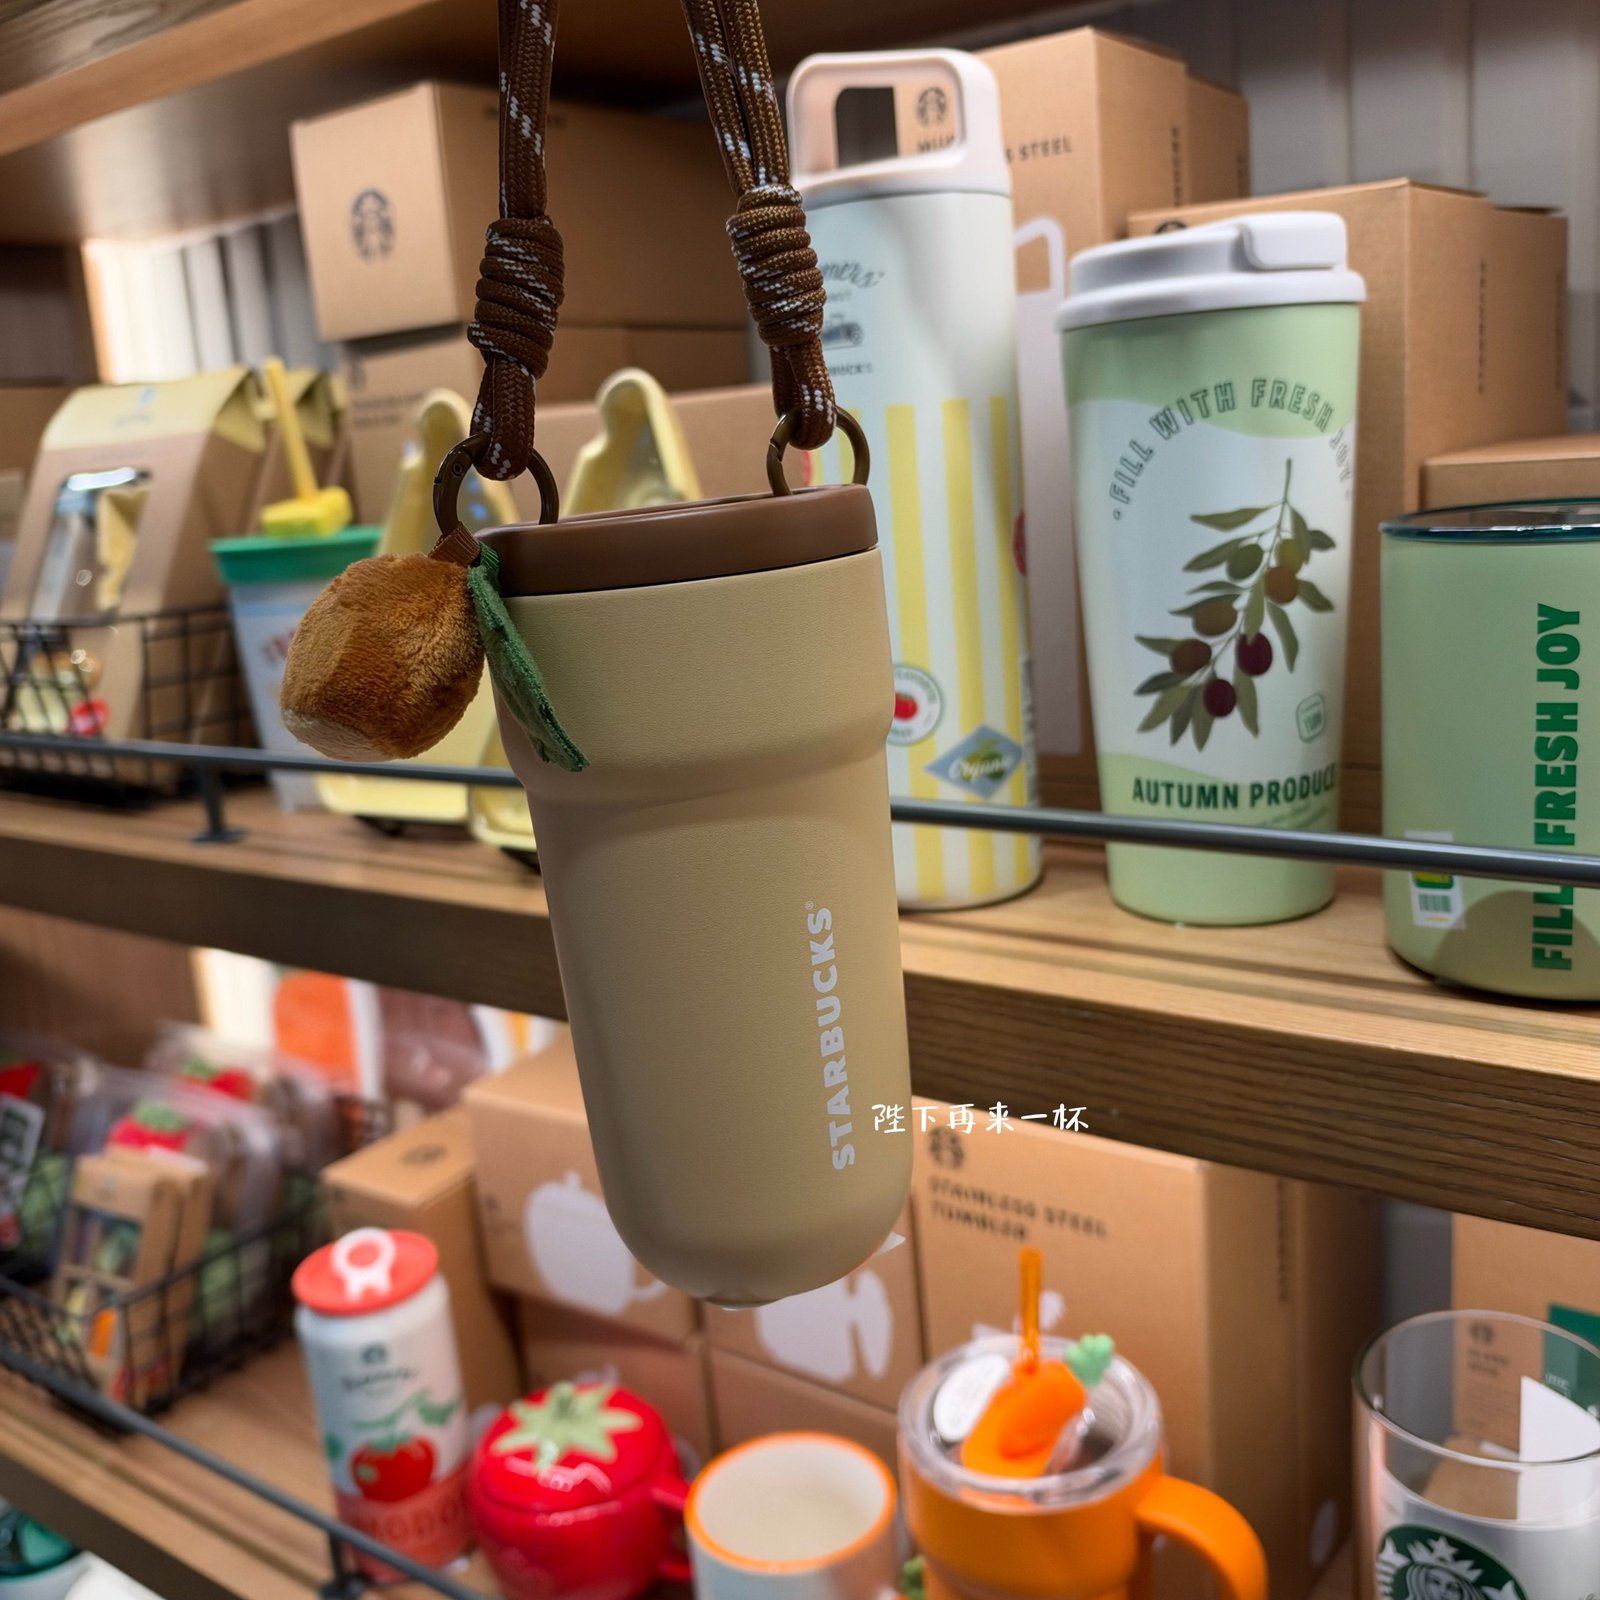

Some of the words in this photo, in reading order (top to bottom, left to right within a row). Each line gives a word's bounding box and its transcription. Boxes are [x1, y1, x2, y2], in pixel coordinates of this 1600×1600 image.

[1018, 135, 1072, 161] STEEL
[1109, 439, 1154, 505] FILL
[1149, 381, 1237, 440] WITH
[1251, 378, 1335, 433] FRESH
[1535, 602, 1581, 691] JOY
[1132, 777, 1239, 809] AUTUMN
[1533, 701, 1580, 847] FRESH
[1043, 1203, 1109, 1241] STEEL
